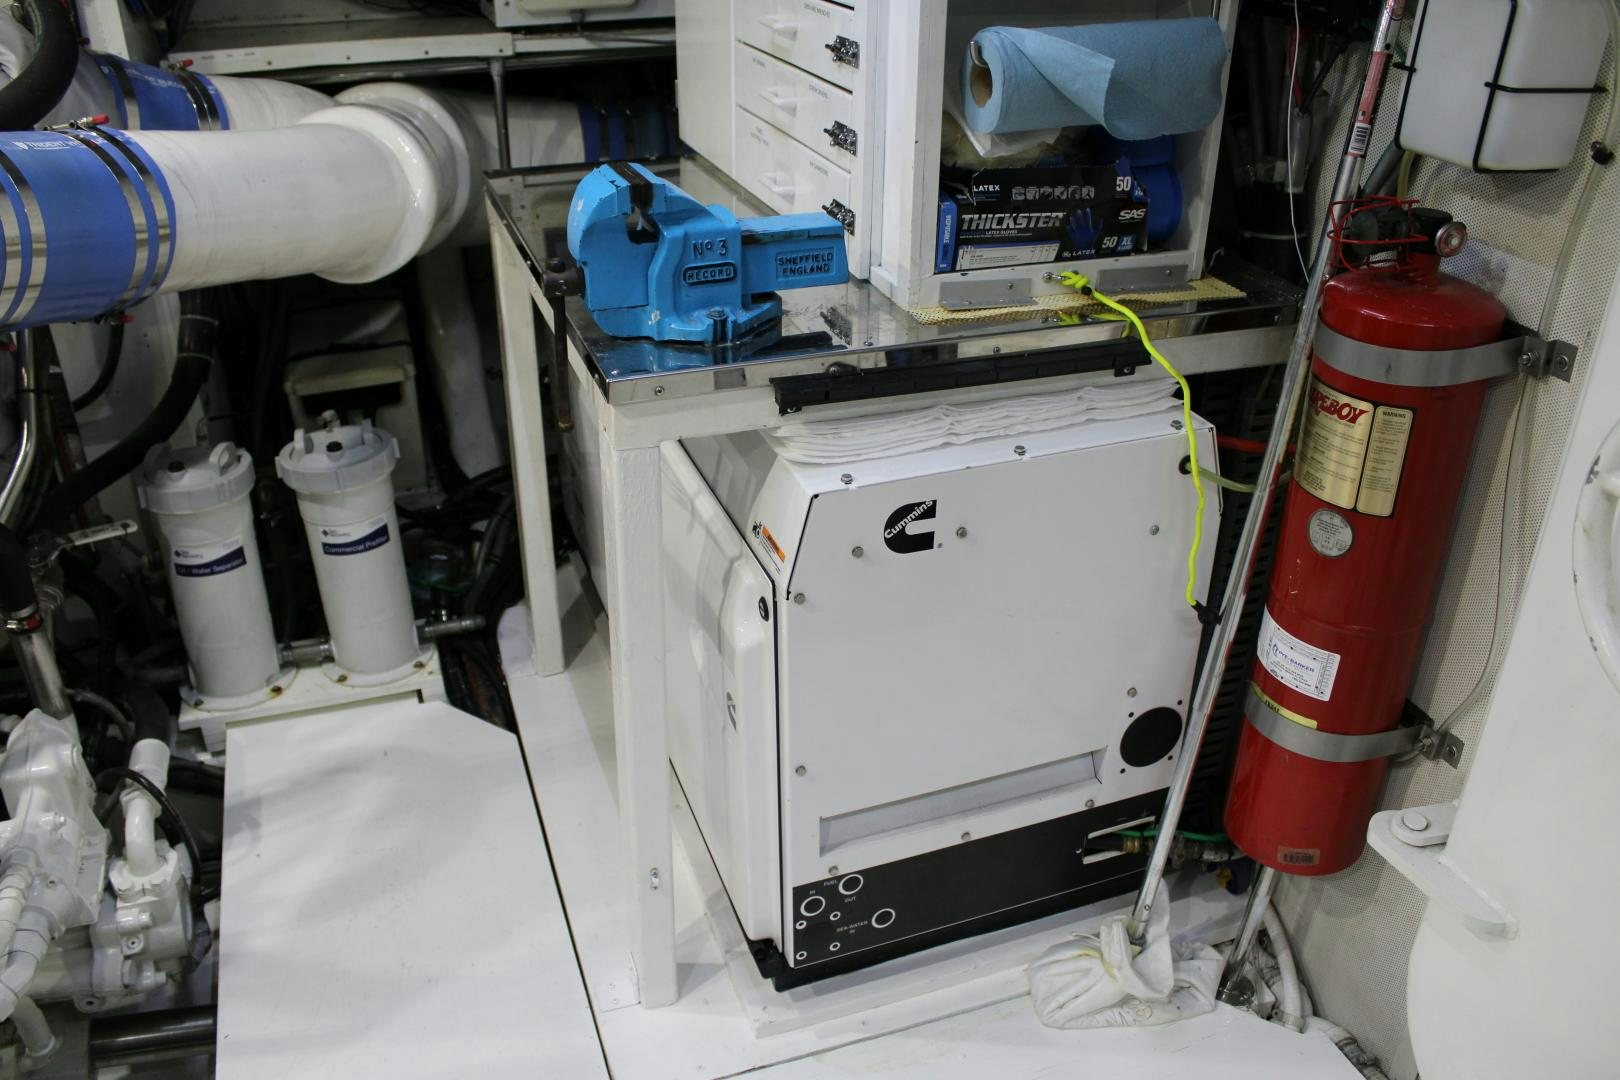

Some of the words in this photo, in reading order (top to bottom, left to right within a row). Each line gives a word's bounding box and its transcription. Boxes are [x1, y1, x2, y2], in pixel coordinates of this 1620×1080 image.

[973, 184, 1000, 192] LATEX
[1116, 176, 1132, 191] 50
[961, 212, 1065, 230] THICKSTER
[1118, 208, 1146, 220] SAS
[717, 237, 729, 257] 3
[1102, 236, 1118, 248] 50
[778, 252, 833, 266] SHEFFIELD
[687, 267, 733, 281] RECORD
[782, 263, 830, 277] ENGLAND
[1309, 386, 1370, 425] IREBOY
[1382, 410, 1407, 420] WARNING
[884, 500, 933, 539] Cummins
[324, 543, 364, 553] Commercial
[836, 920, 868, 932] SEA-WATER
